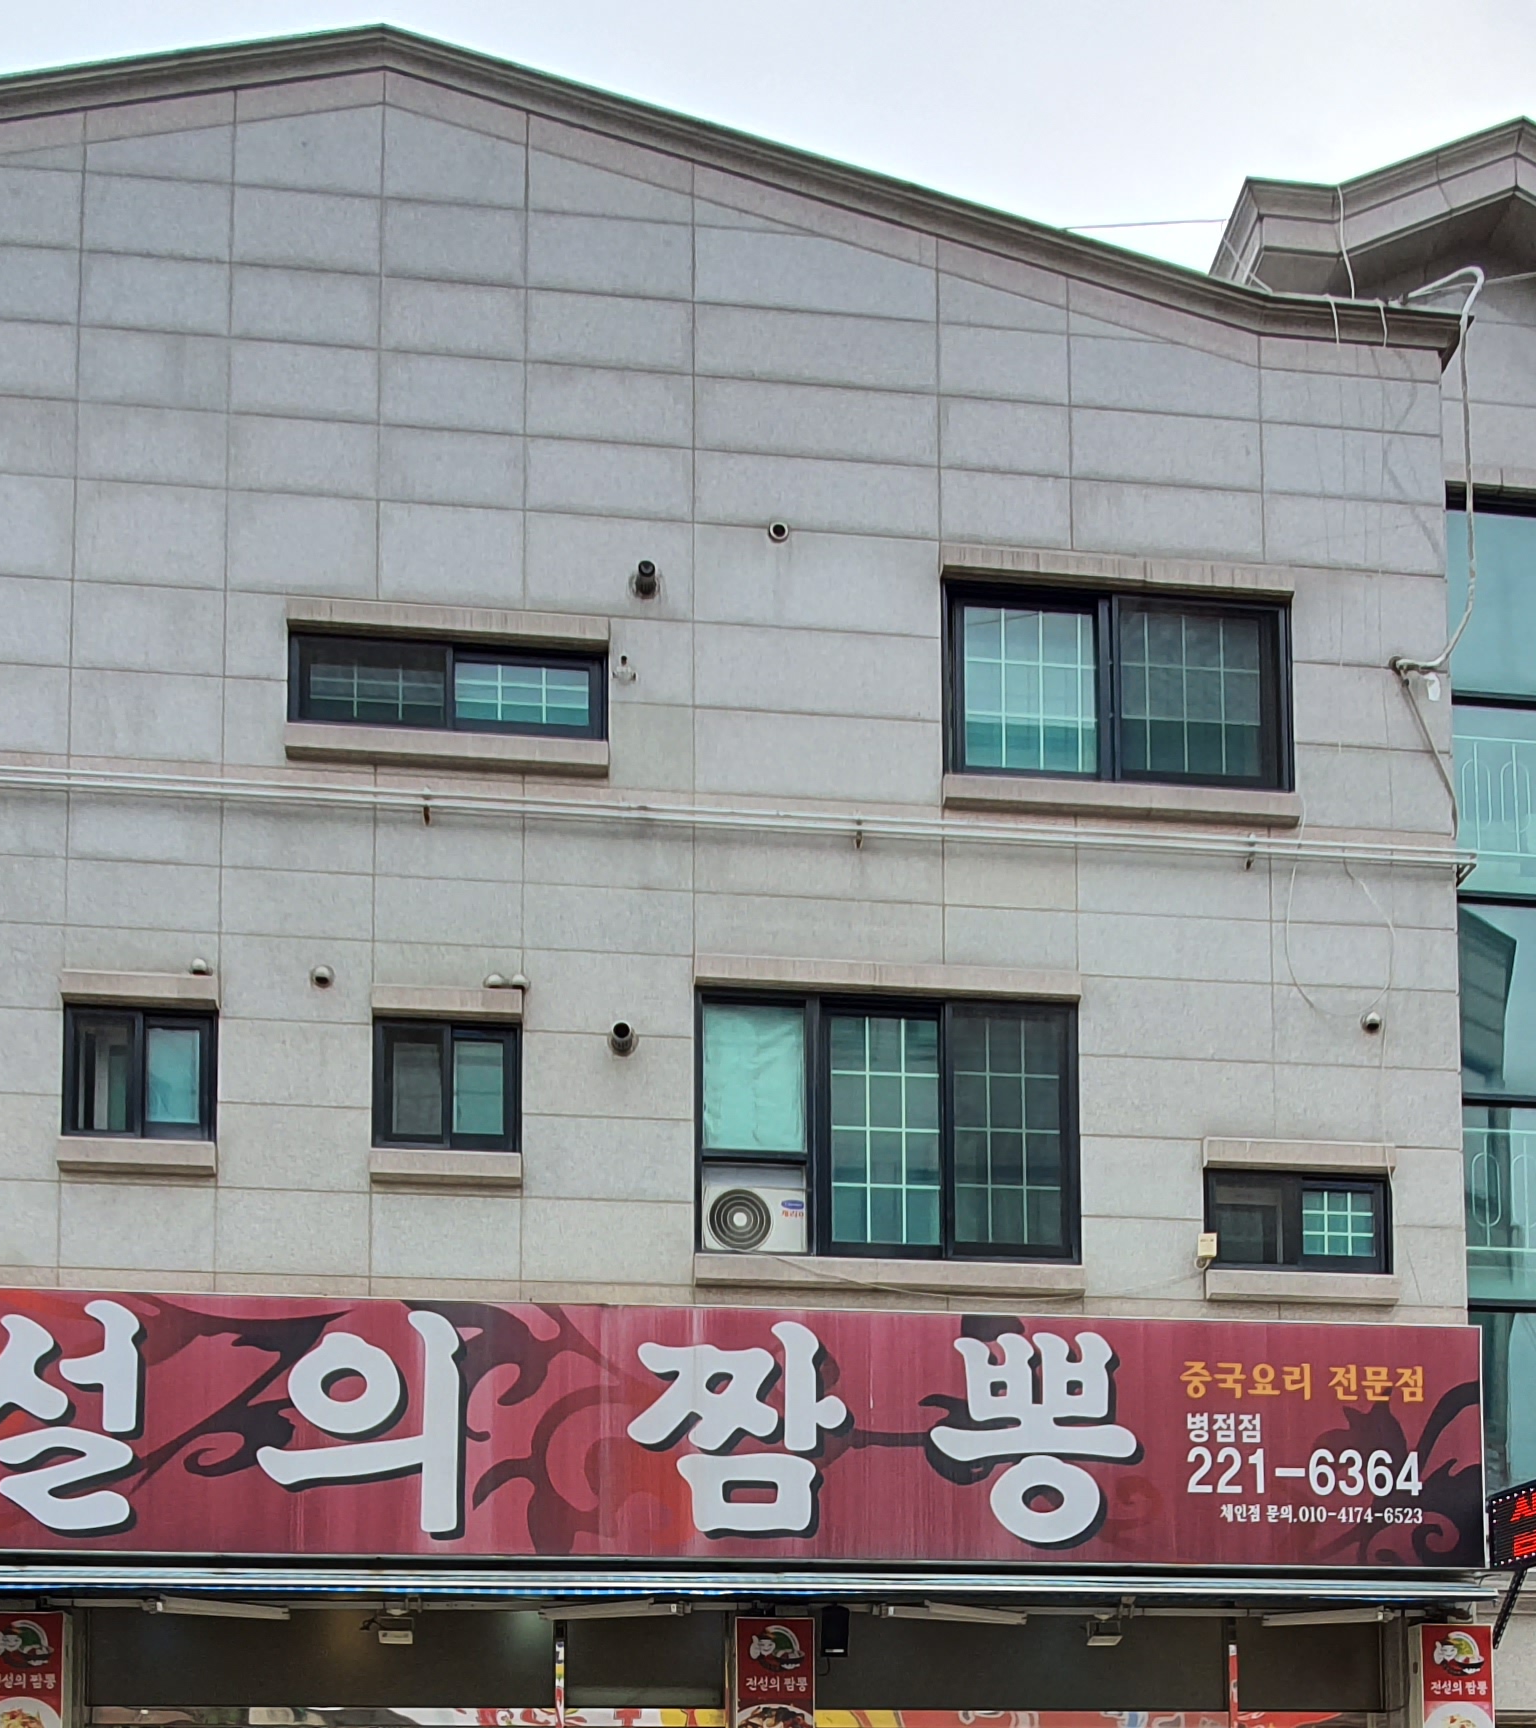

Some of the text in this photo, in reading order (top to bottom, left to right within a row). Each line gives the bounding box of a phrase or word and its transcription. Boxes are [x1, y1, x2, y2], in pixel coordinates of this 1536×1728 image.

[1178, 1361, 1426, 1403] 중국요리 전문점
[1185, 1412, 1262, 1444] 병점점
[1185, 1445, 1423, 1497] 221-6364
[1219, 1504, 1261, 1523] 체인점
[745, 1676, 781, 1693] 전설의
[1430, 1680, 1463, 1696] 전설의
